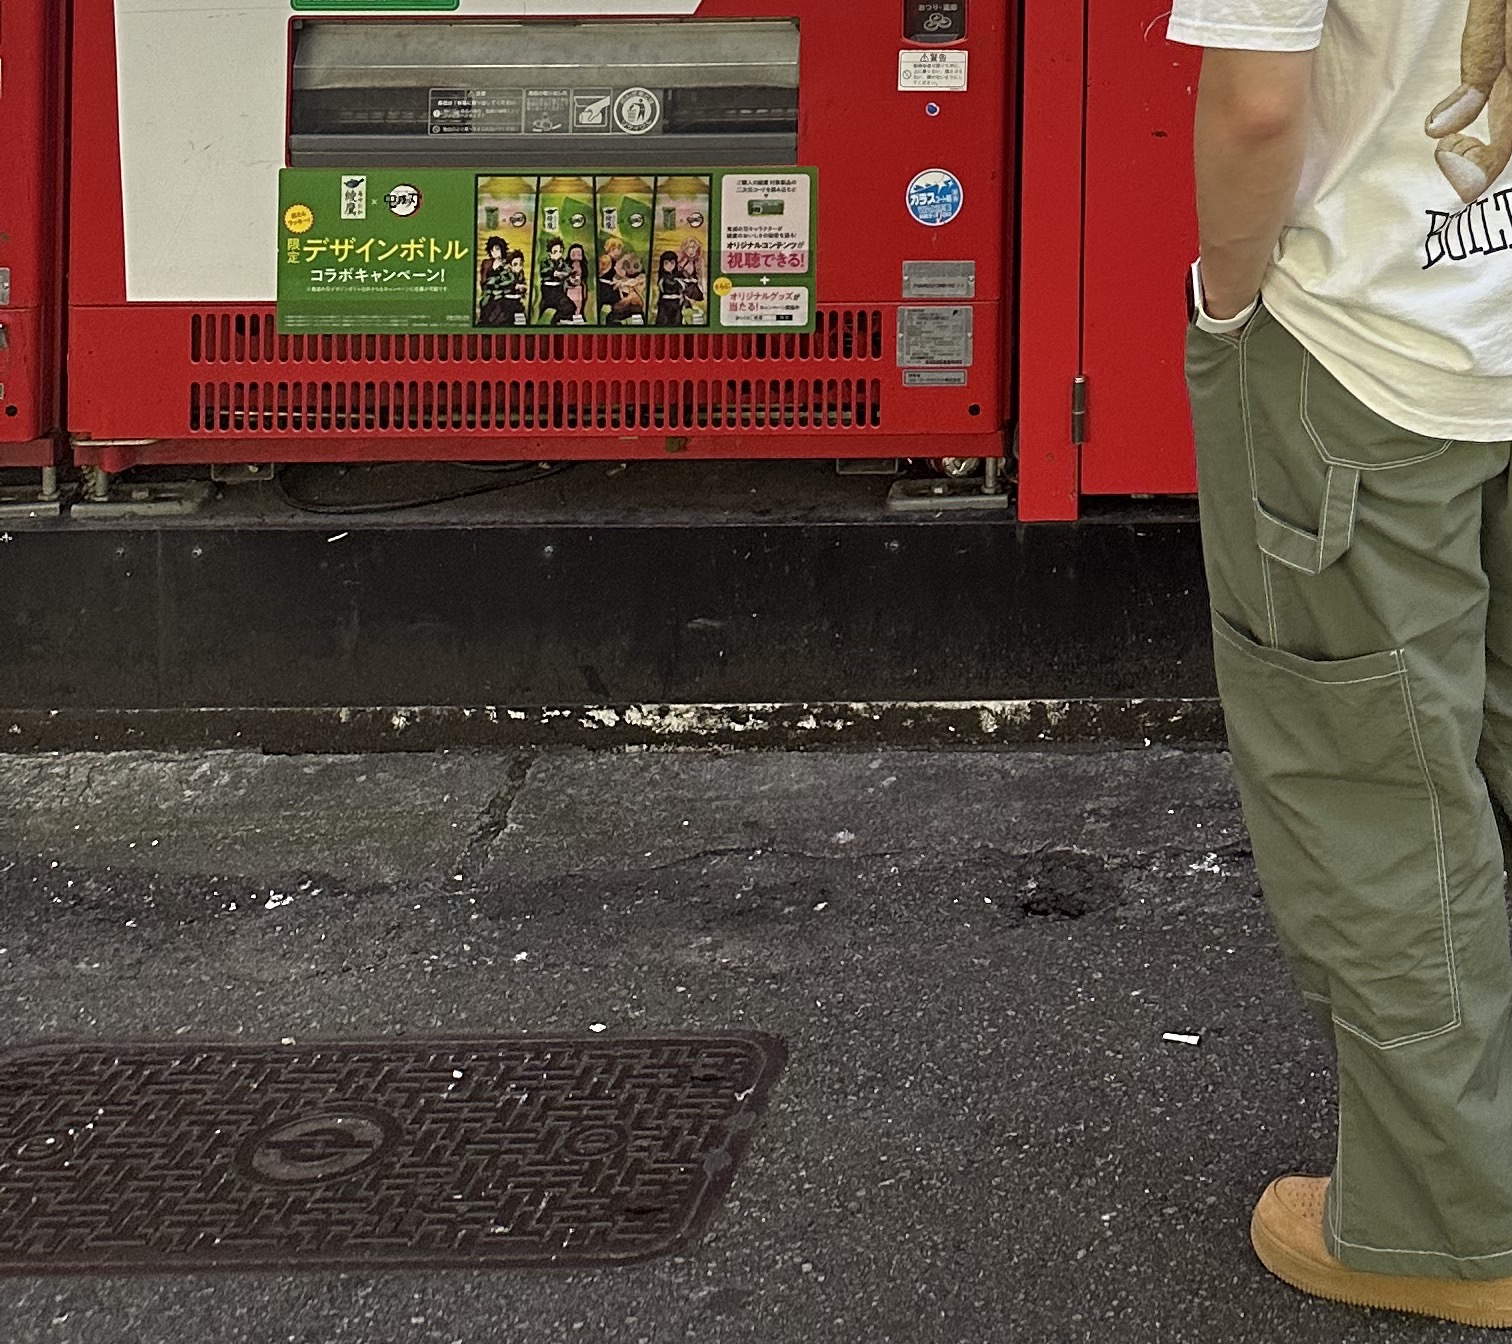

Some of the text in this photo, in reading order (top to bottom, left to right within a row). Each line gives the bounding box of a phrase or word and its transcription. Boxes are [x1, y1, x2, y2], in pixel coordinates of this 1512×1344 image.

[286, 238, 301, 264] 限定
[303, 237, 469, 264] デザインボトル
[727, 252, 805, 270] 視聴できる!
[310, 268, 446, 284] コラボキャンペーン!
